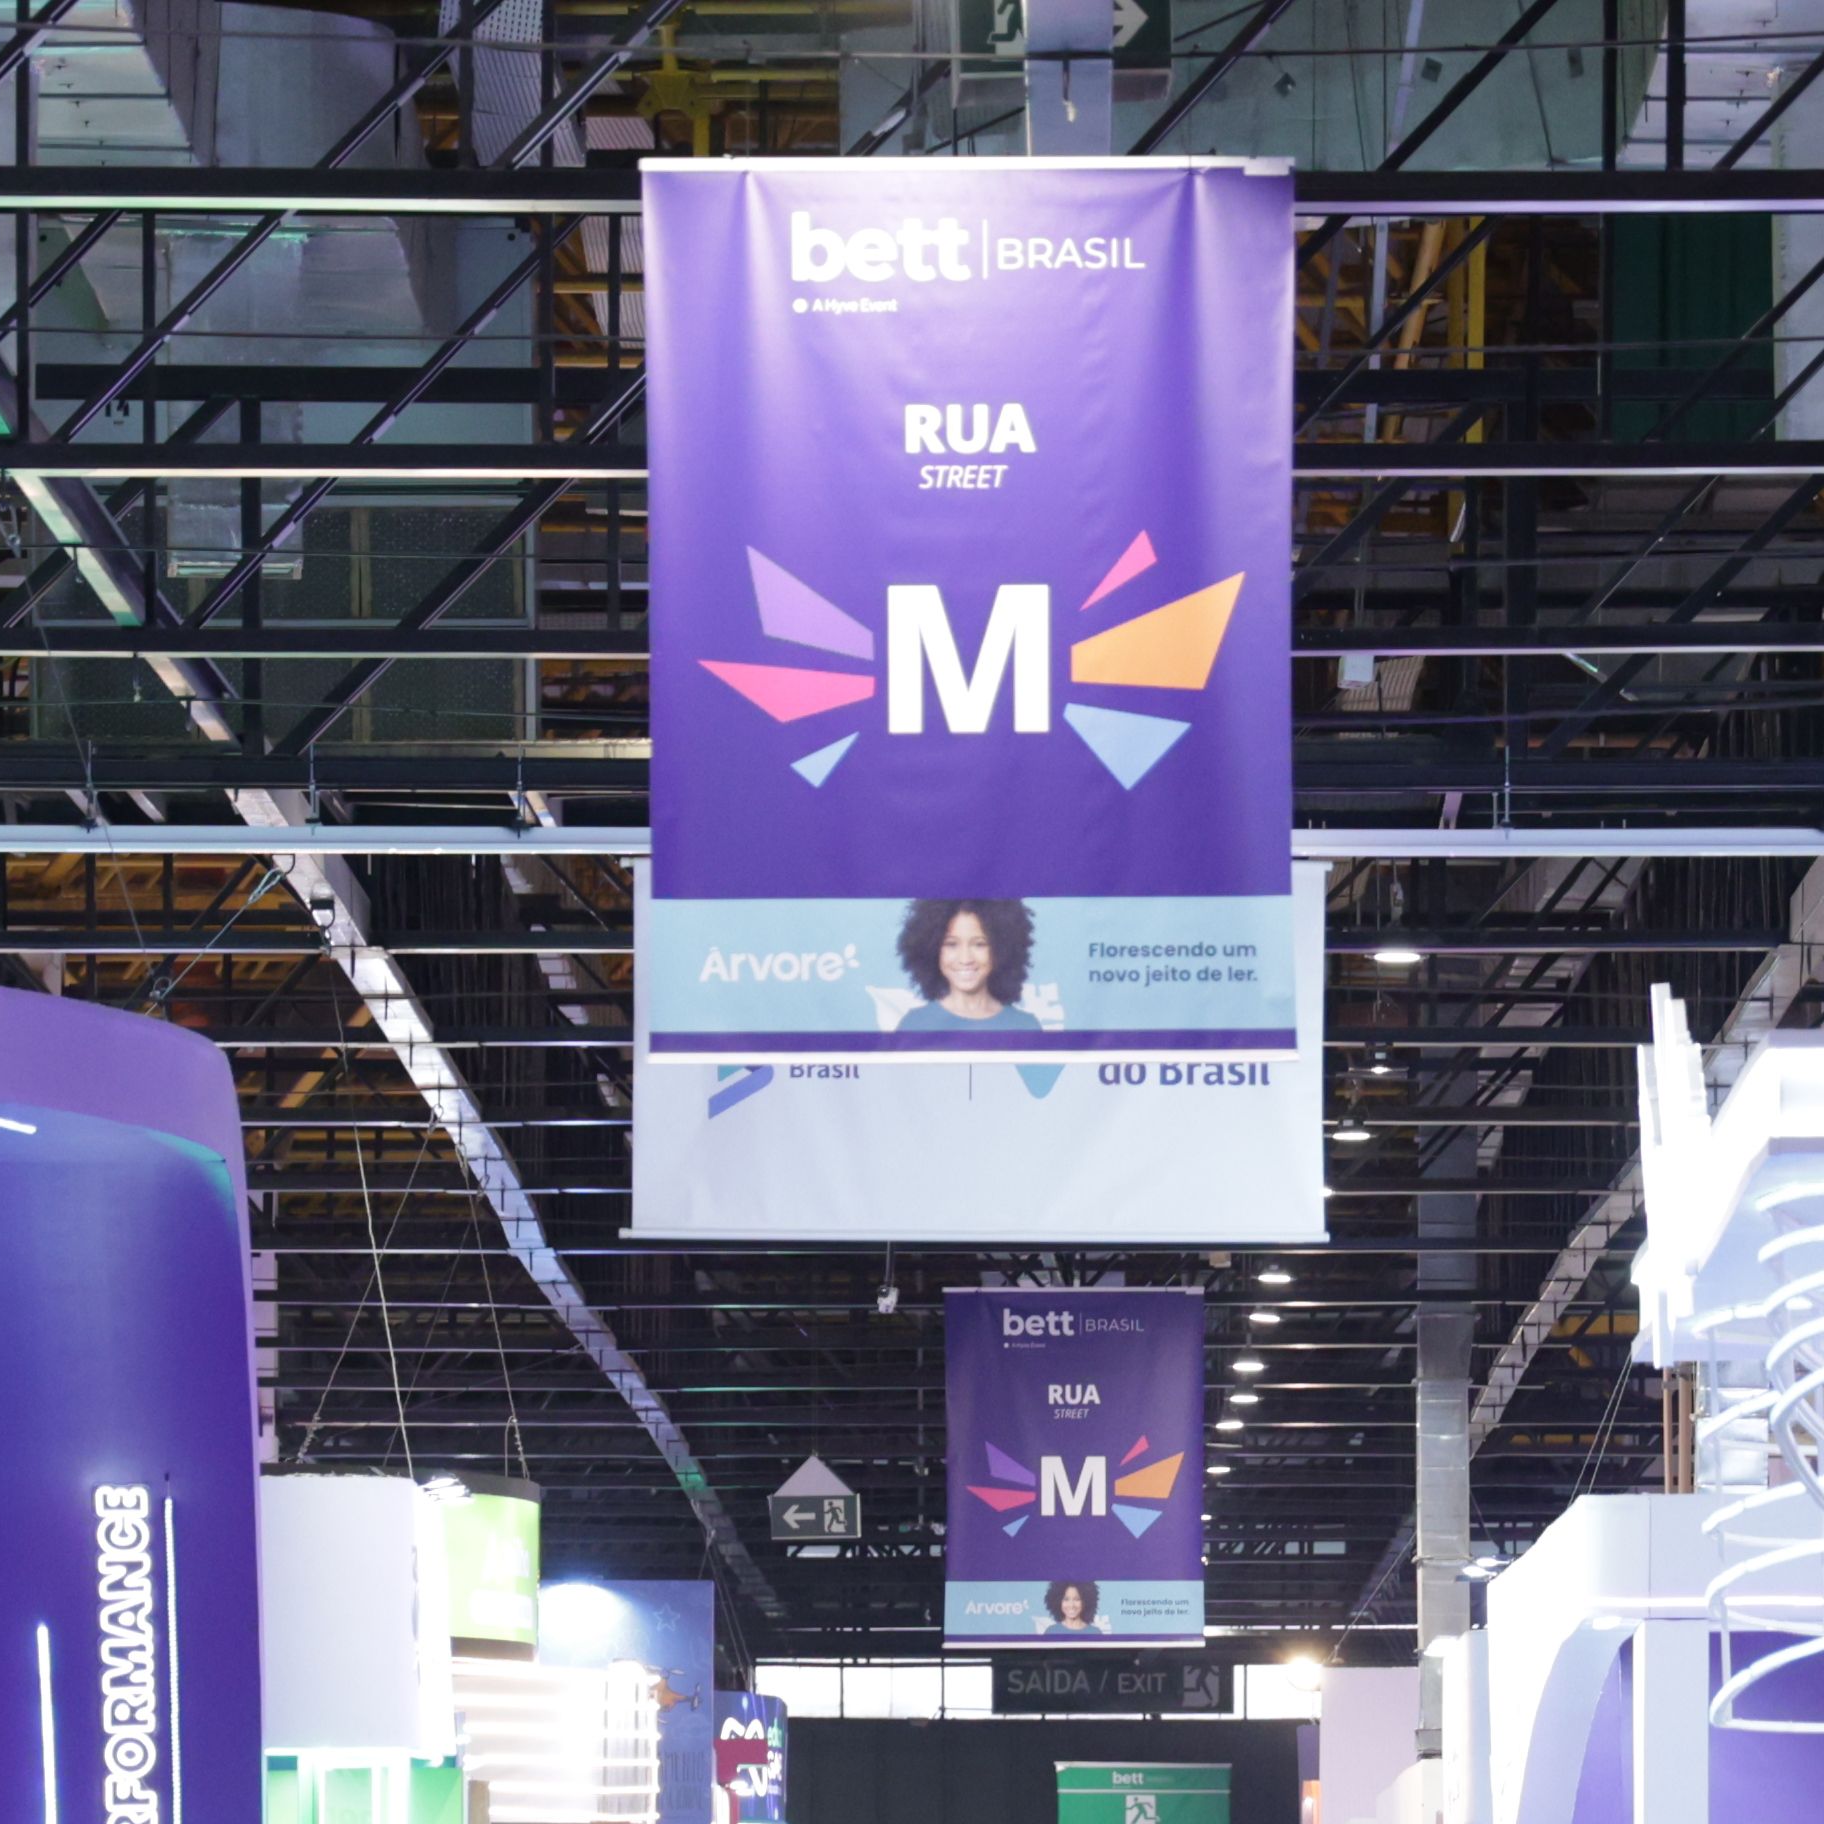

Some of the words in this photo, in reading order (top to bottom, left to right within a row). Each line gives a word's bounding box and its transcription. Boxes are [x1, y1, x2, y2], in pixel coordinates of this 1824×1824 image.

[790, 211, 972, 282] bett
[997, 237, 1146, 270] BRASIL
[904, 403, 1037, 454] RUA
[919, 465, 1008, 489] STREET
[887, 584, 1051, 734] M
[1088, 941, 1218, 959] Florescendo
[1222, 943, 1258, 958] um
[1088, 968, 1141, 983] novo
[1145, 965, 1192, 987] jeito
[1196, 966, 1223, 983] de
[1227, 966, 1259, 983] ler.
[789, 1064, 861, 1080] Brasil
[1158, 1063, 1272, 1087] Brasil
[1002, 1308, 1075, 1337] bett
[1084, 1318, 1145, 1333] BRASIL
[1047, 1383, 1102, 1406] RUA
[1053, 1408, 1090, 1419] STREET
[1040, 1456, 1107, 1517] M
[1117, 1673, 1167, 1694] EXIT
[1112, 1771, 1144, 1785] bett
